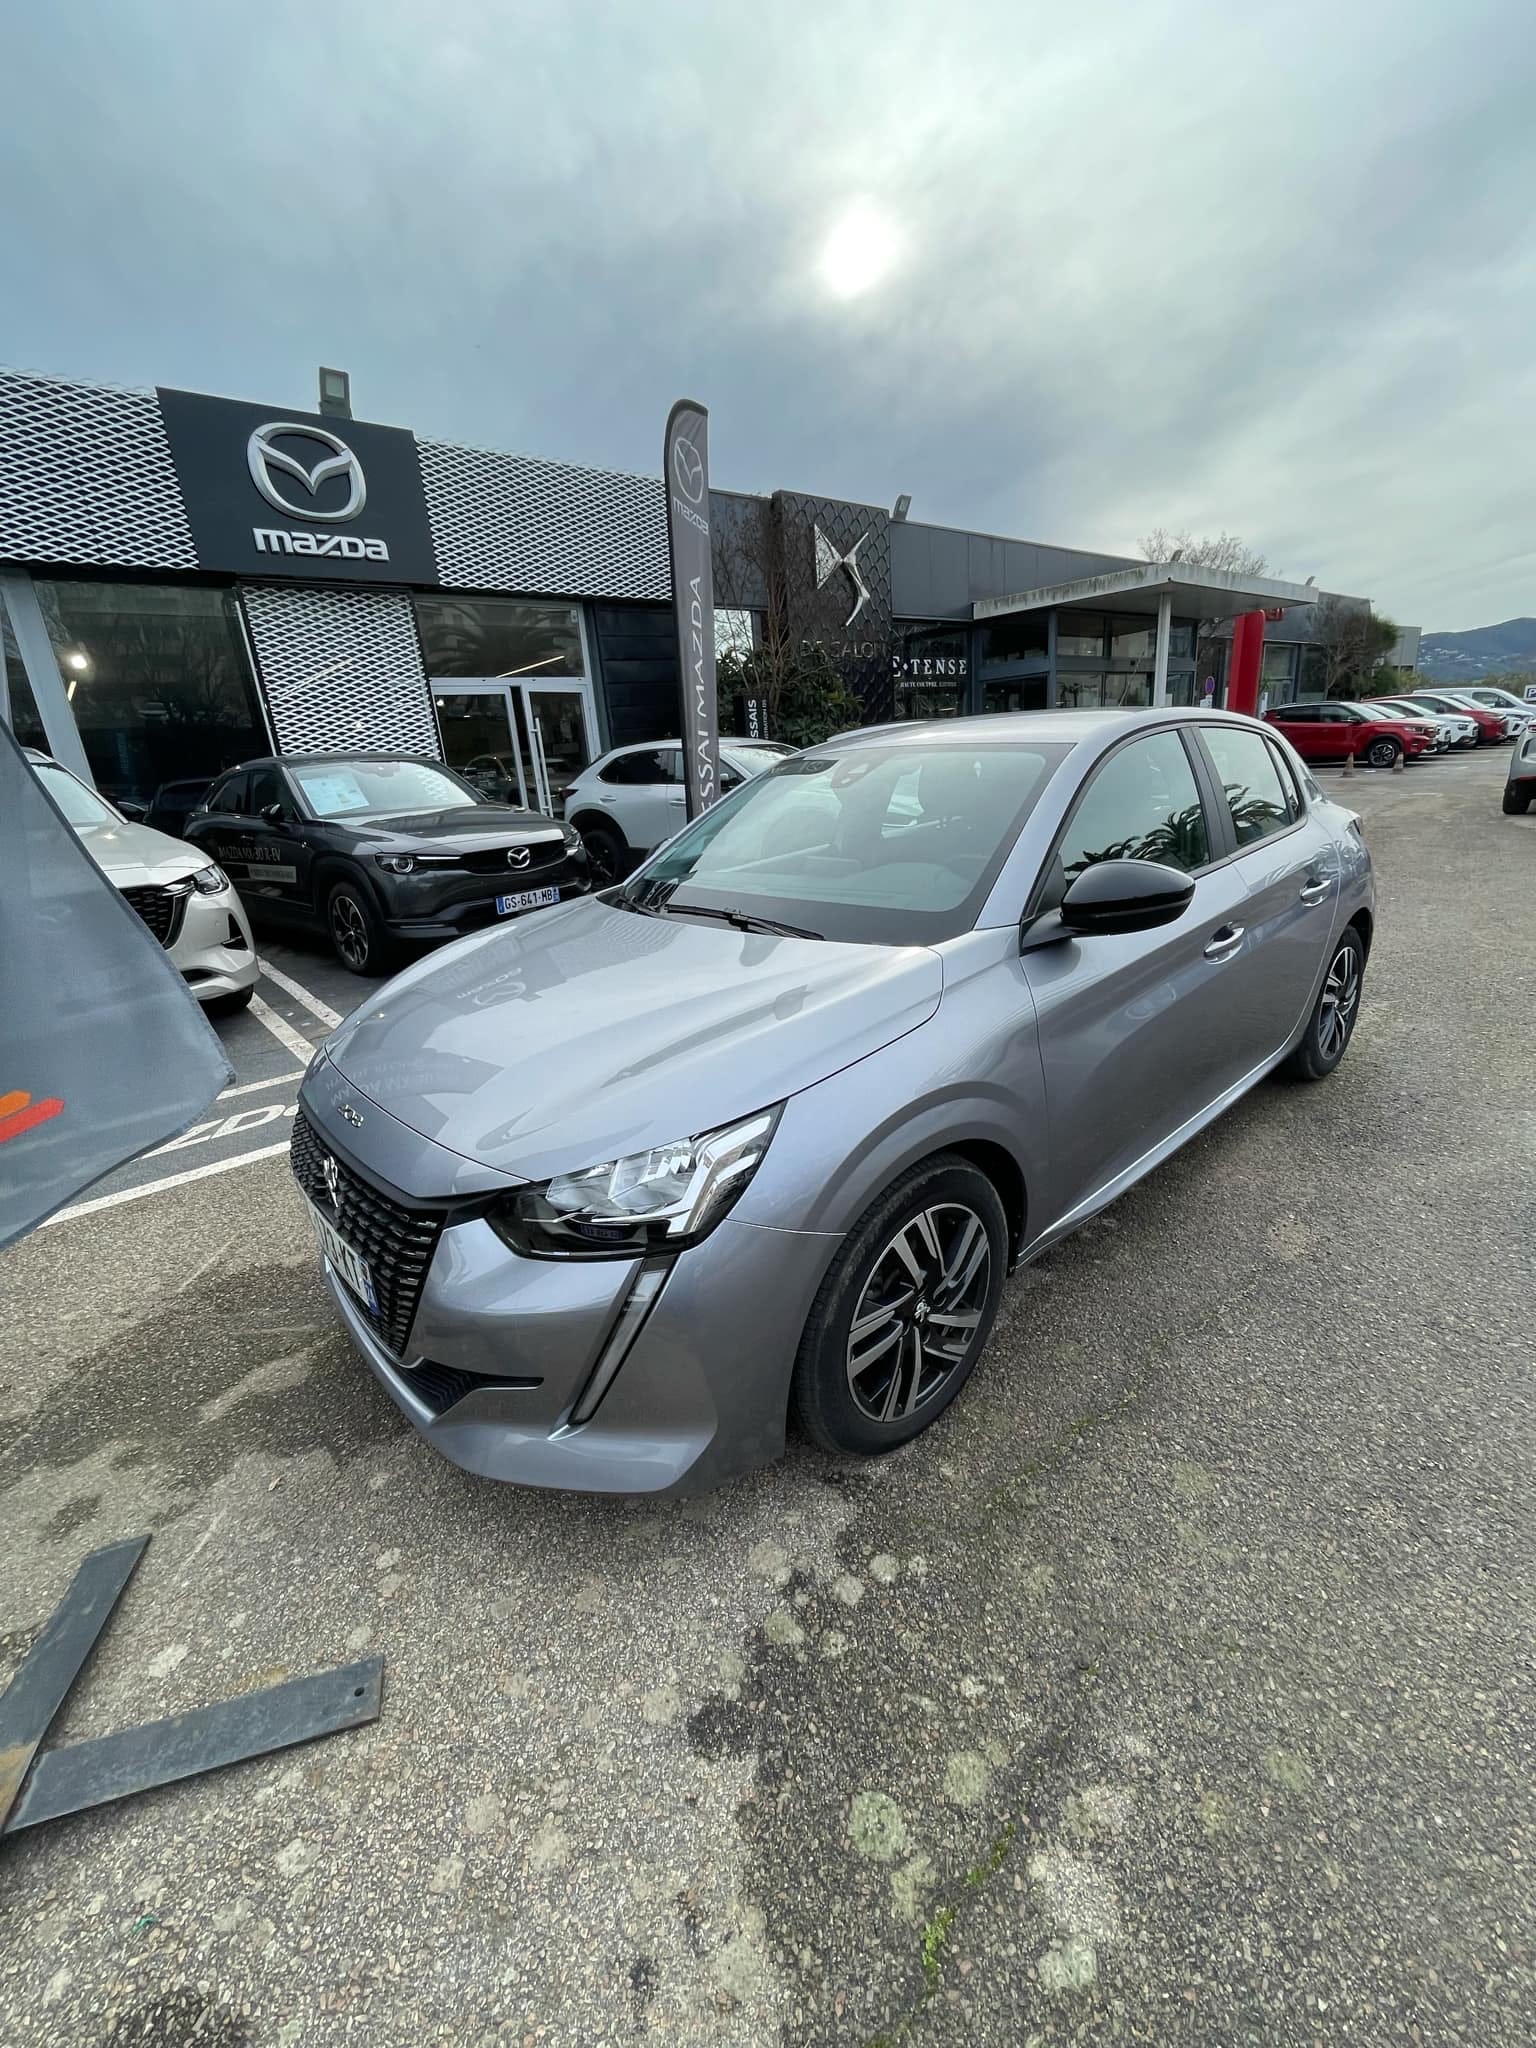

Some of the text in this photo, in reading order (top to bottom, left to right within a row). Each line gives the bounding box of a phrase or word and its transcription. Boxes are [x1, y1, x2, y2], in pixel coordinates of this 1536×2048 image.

[672, 495, 709, 537] mazda
[252, 527, 390, 561] mazda
[689, 576, 707, 717] MAZDA
[747, 699, 759, 738] SSAIS
